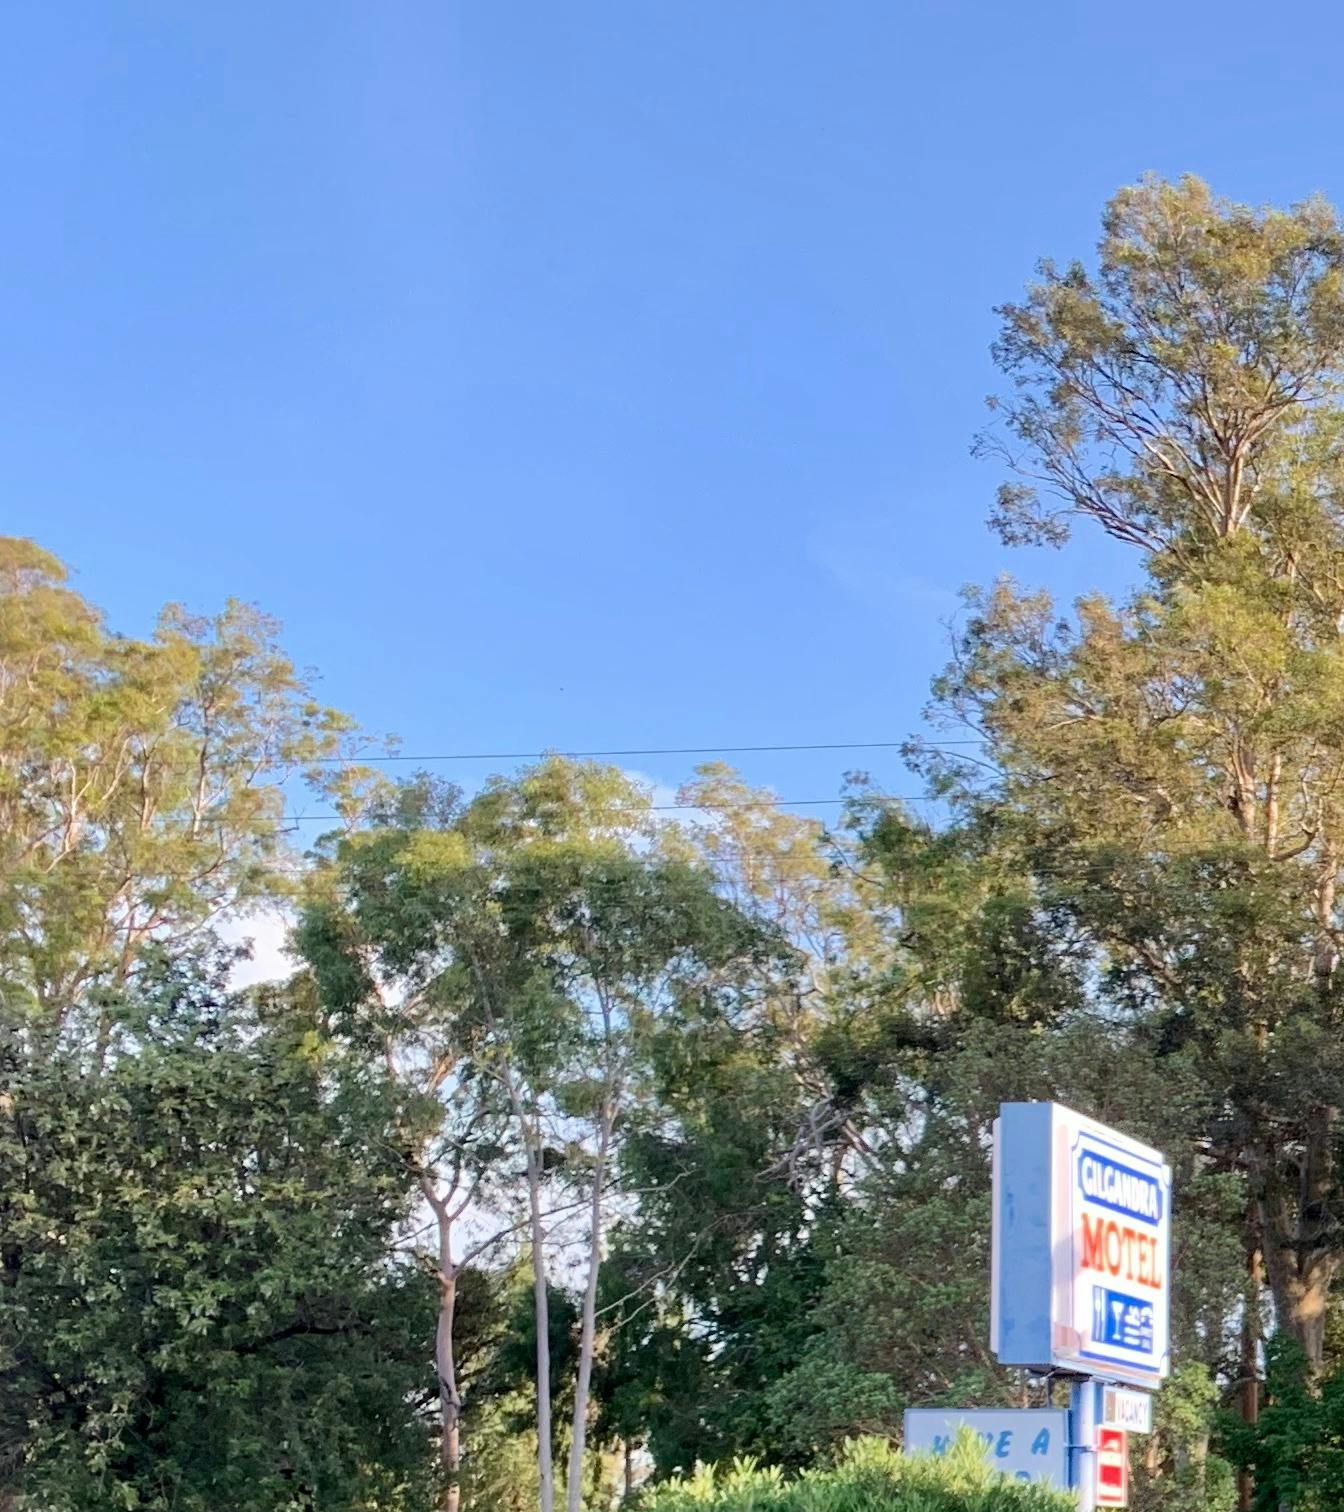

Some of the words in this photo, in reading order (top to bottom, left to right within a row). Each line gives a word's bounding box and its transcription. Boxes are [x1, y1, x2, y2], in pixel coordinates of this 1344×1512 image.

[1082, 1156, 1158, 1220] GILGANDRA
[1081, 1212, 1161, 1289] MOTEL
[1031, 1427, 1050, 1455] A
